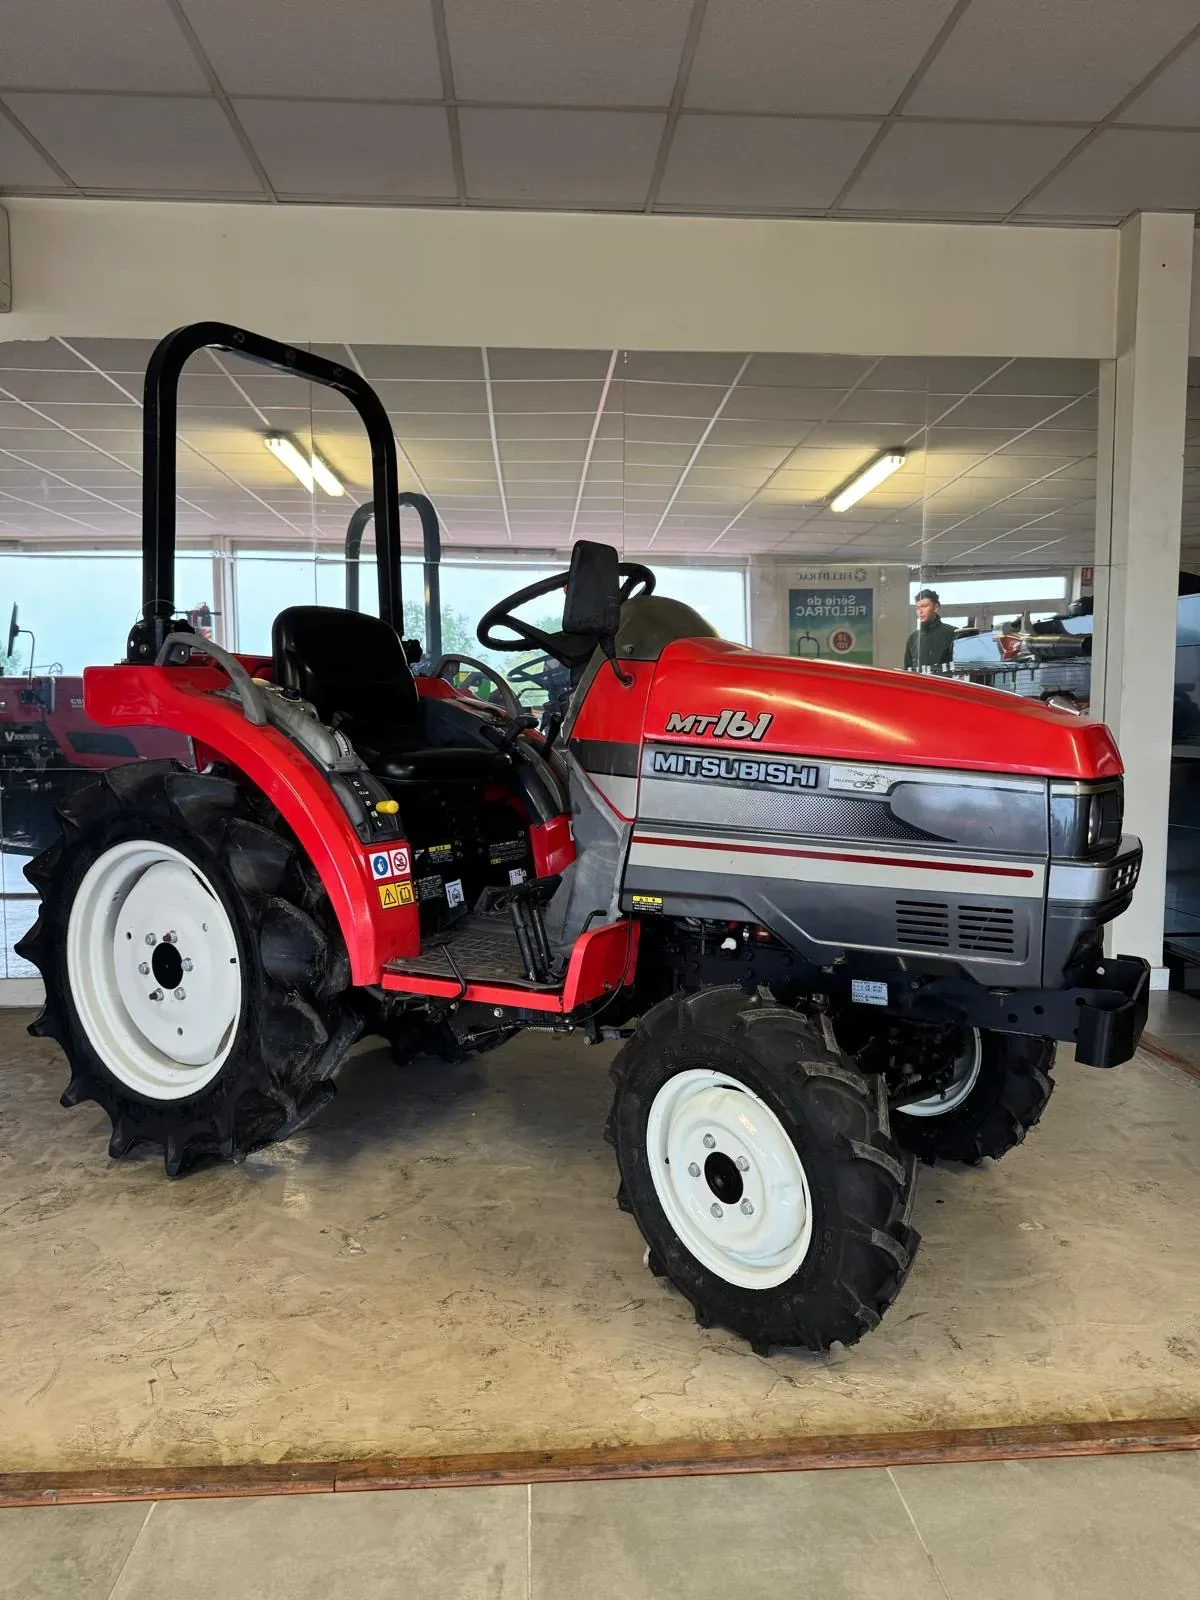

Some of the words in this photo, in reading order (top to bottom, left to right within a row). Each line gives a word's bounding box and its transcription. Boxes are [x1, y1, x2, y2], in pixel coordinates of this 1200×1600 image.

[665, 710, 774, 741] MT161
[653, 752, 819, 788] MITSUBISHI
[853, 780, 875, 790] GS
